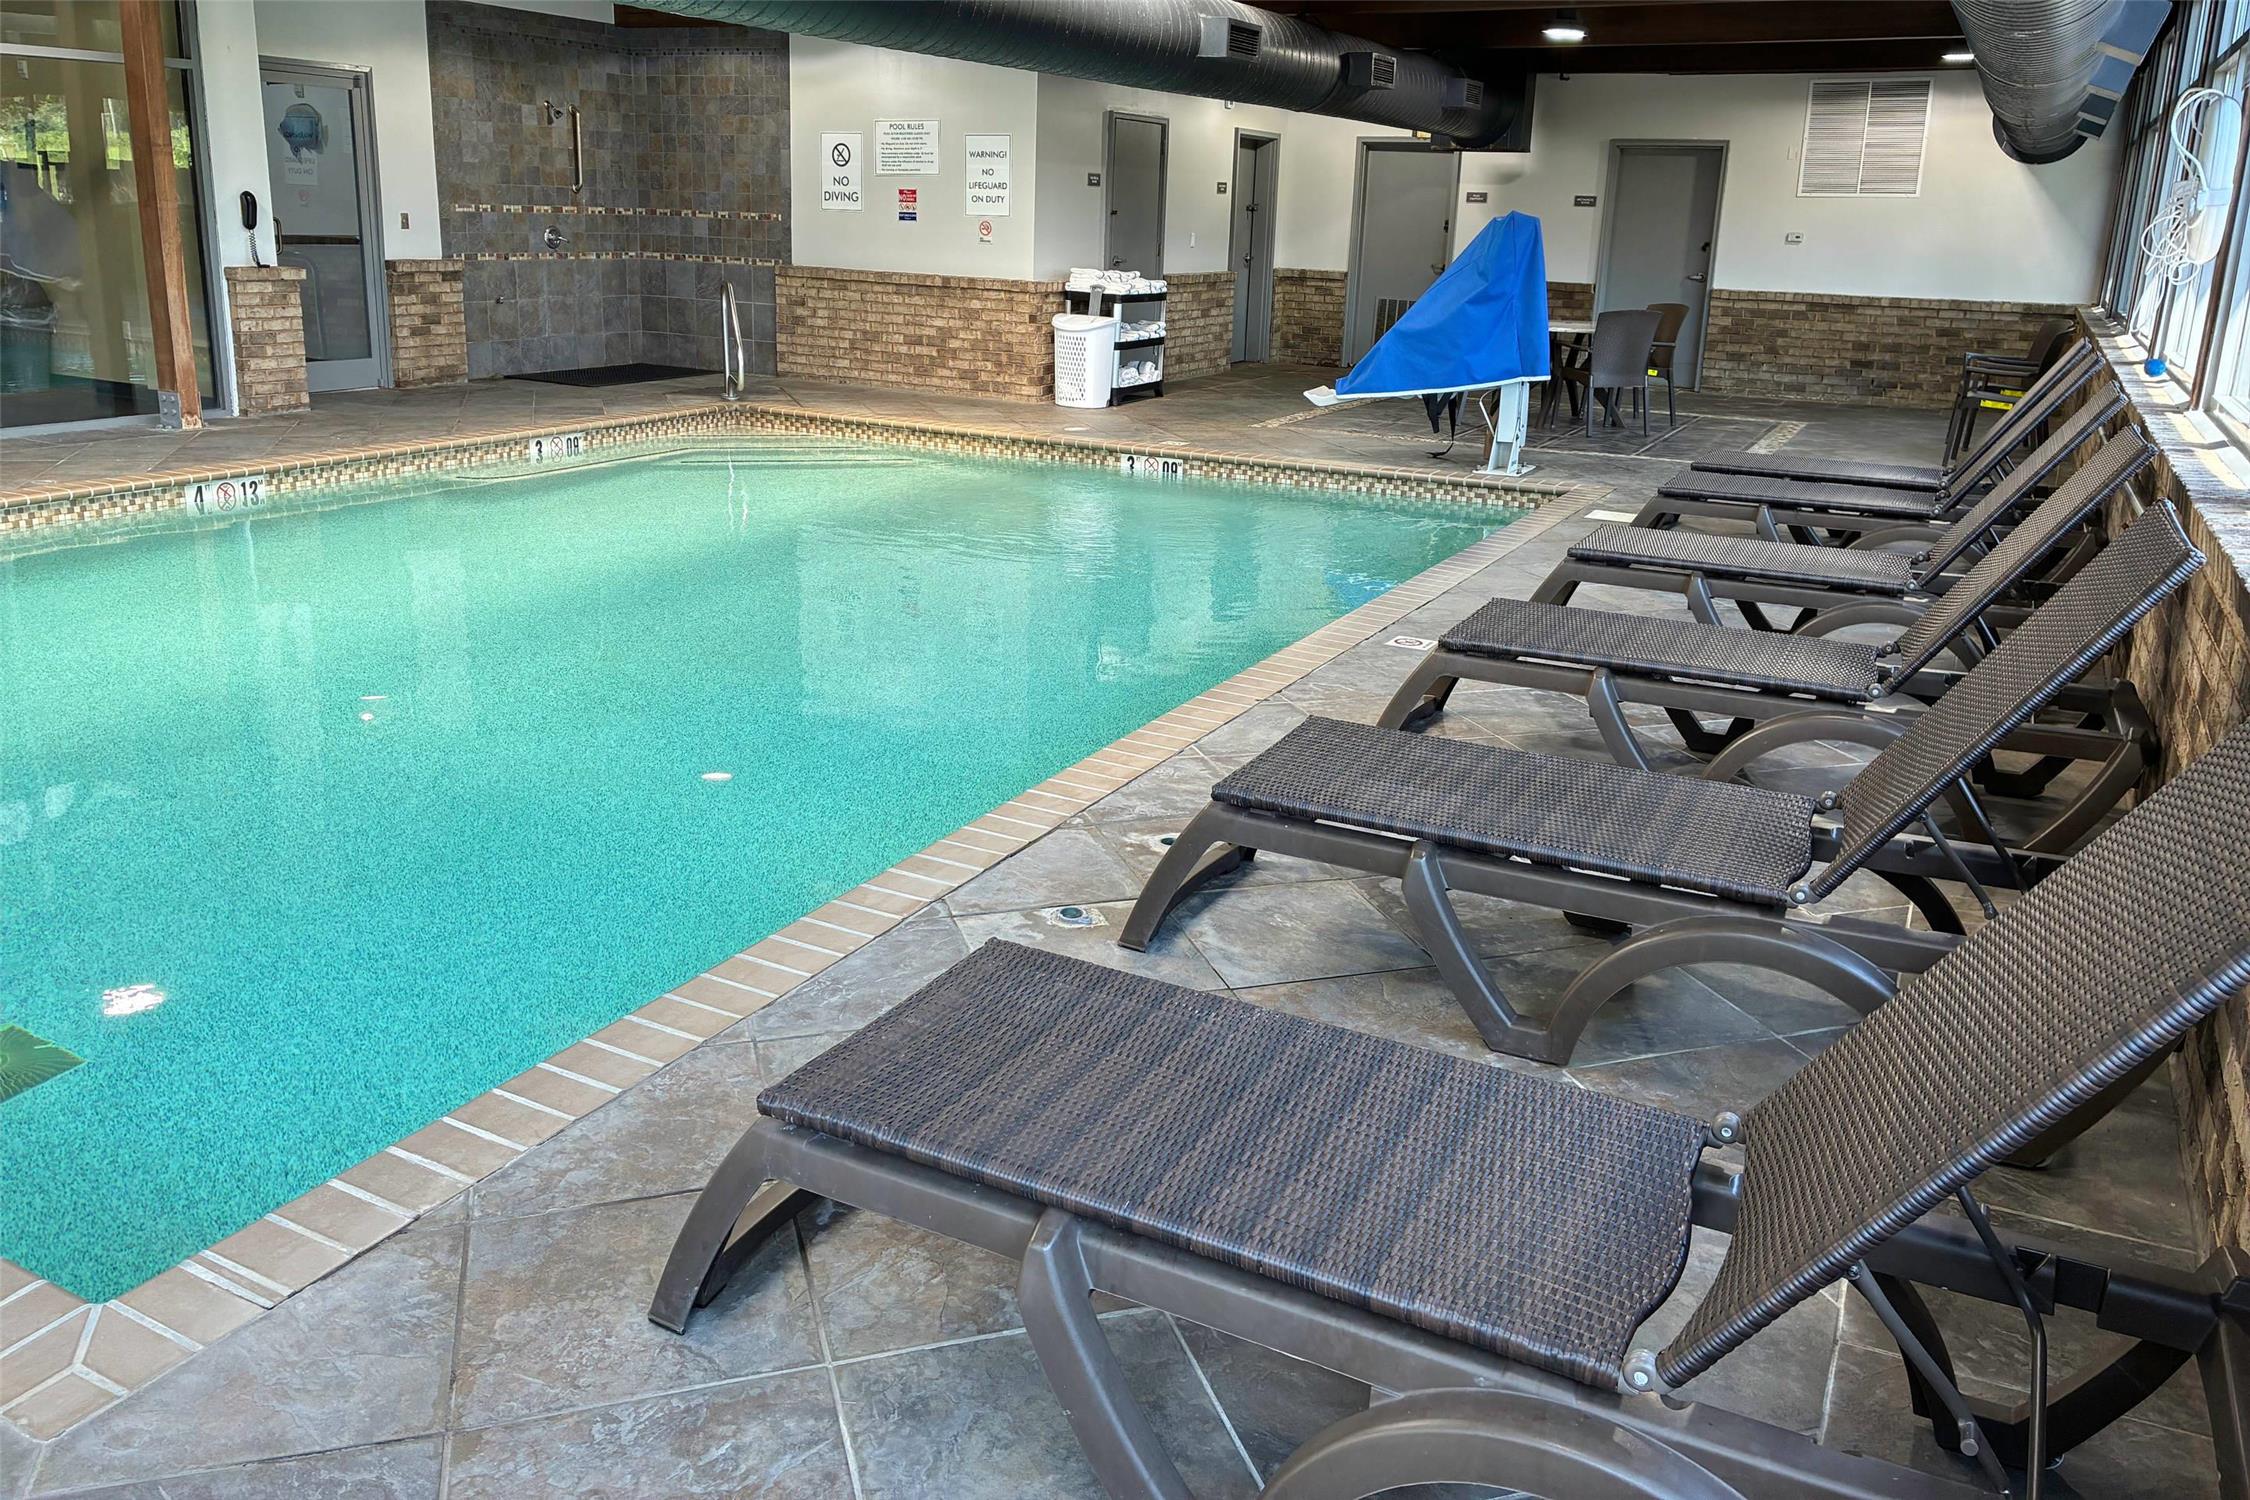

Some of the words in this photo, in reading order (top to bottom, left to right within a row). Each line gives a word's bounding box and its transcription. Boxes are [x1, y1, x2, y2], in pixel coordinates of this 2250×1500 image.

[969, 150, 1007, 158] WARNING!
[981, 168, 995, 176] NO
[833, 175, 850, 187] NO
[968, 181, 1008, 190] LIFEGUARD
[824, 190, 859, 202] DIVING
[971, 195, 984, 203] ON
[985, 195, 1005, 203] DUTY
